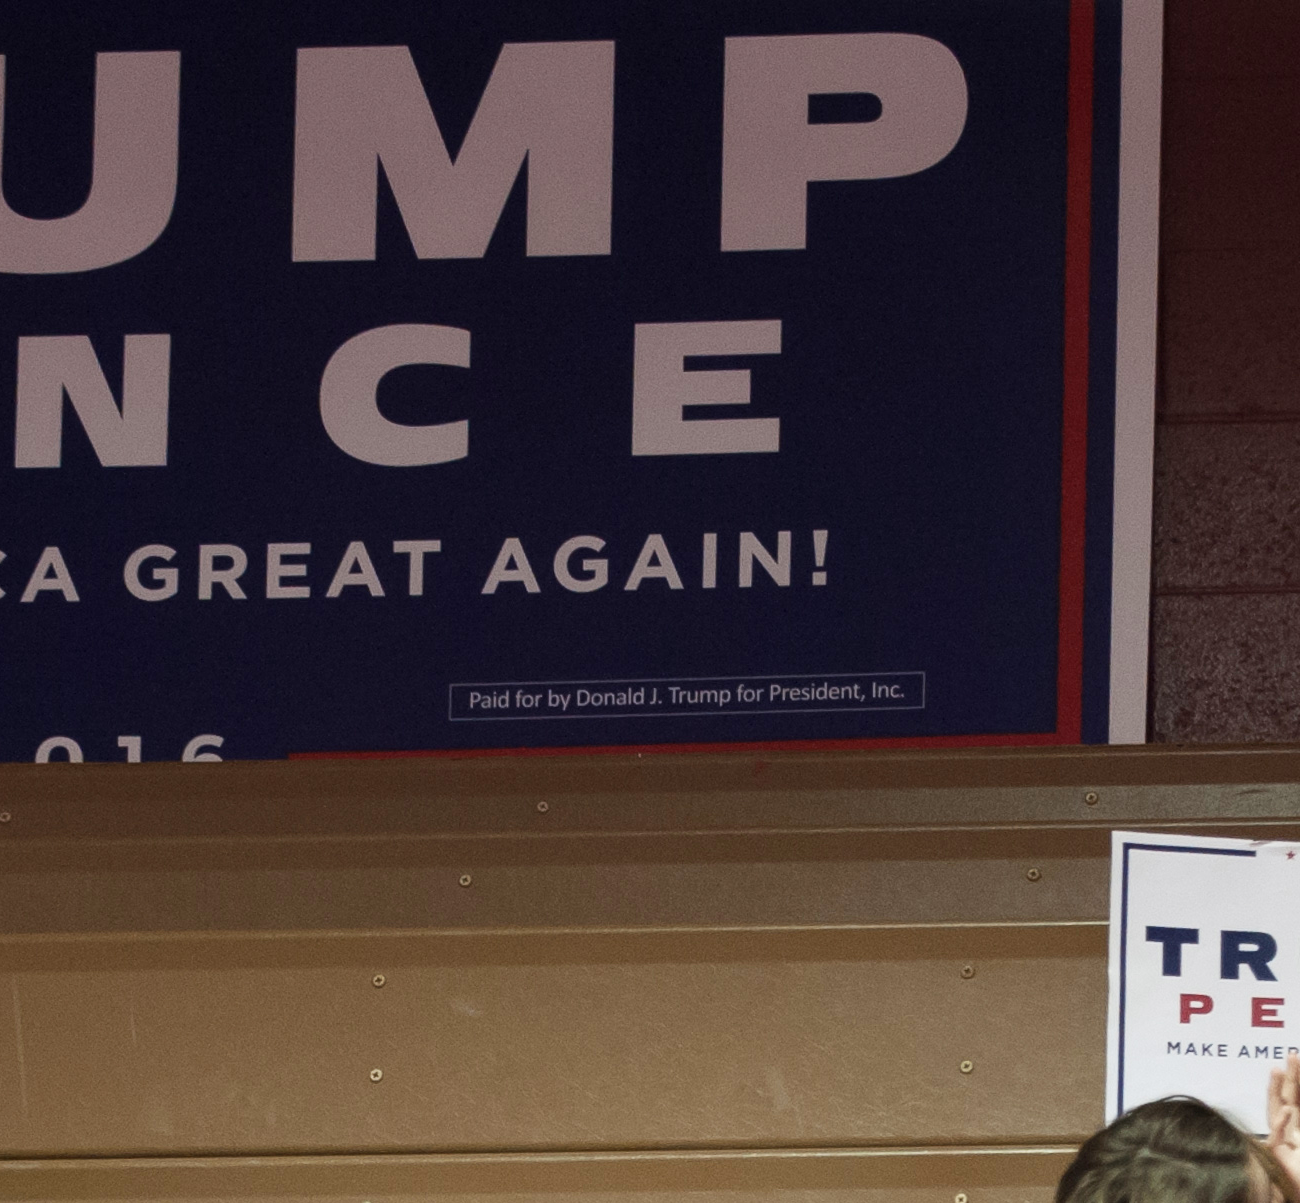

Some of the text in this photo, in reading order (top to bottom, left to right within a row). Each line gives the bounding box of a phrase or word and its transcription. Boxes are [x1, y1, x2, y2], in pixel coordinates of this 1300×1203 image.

[122, 539, 443, 602] GREAT
[480, 529, 830, 596] AGAIN!
[469, 681, 906, 711] Paid for by Donald J. Trump for President, Inc.
[1166, 1041, 1229, 1057] MAKE
